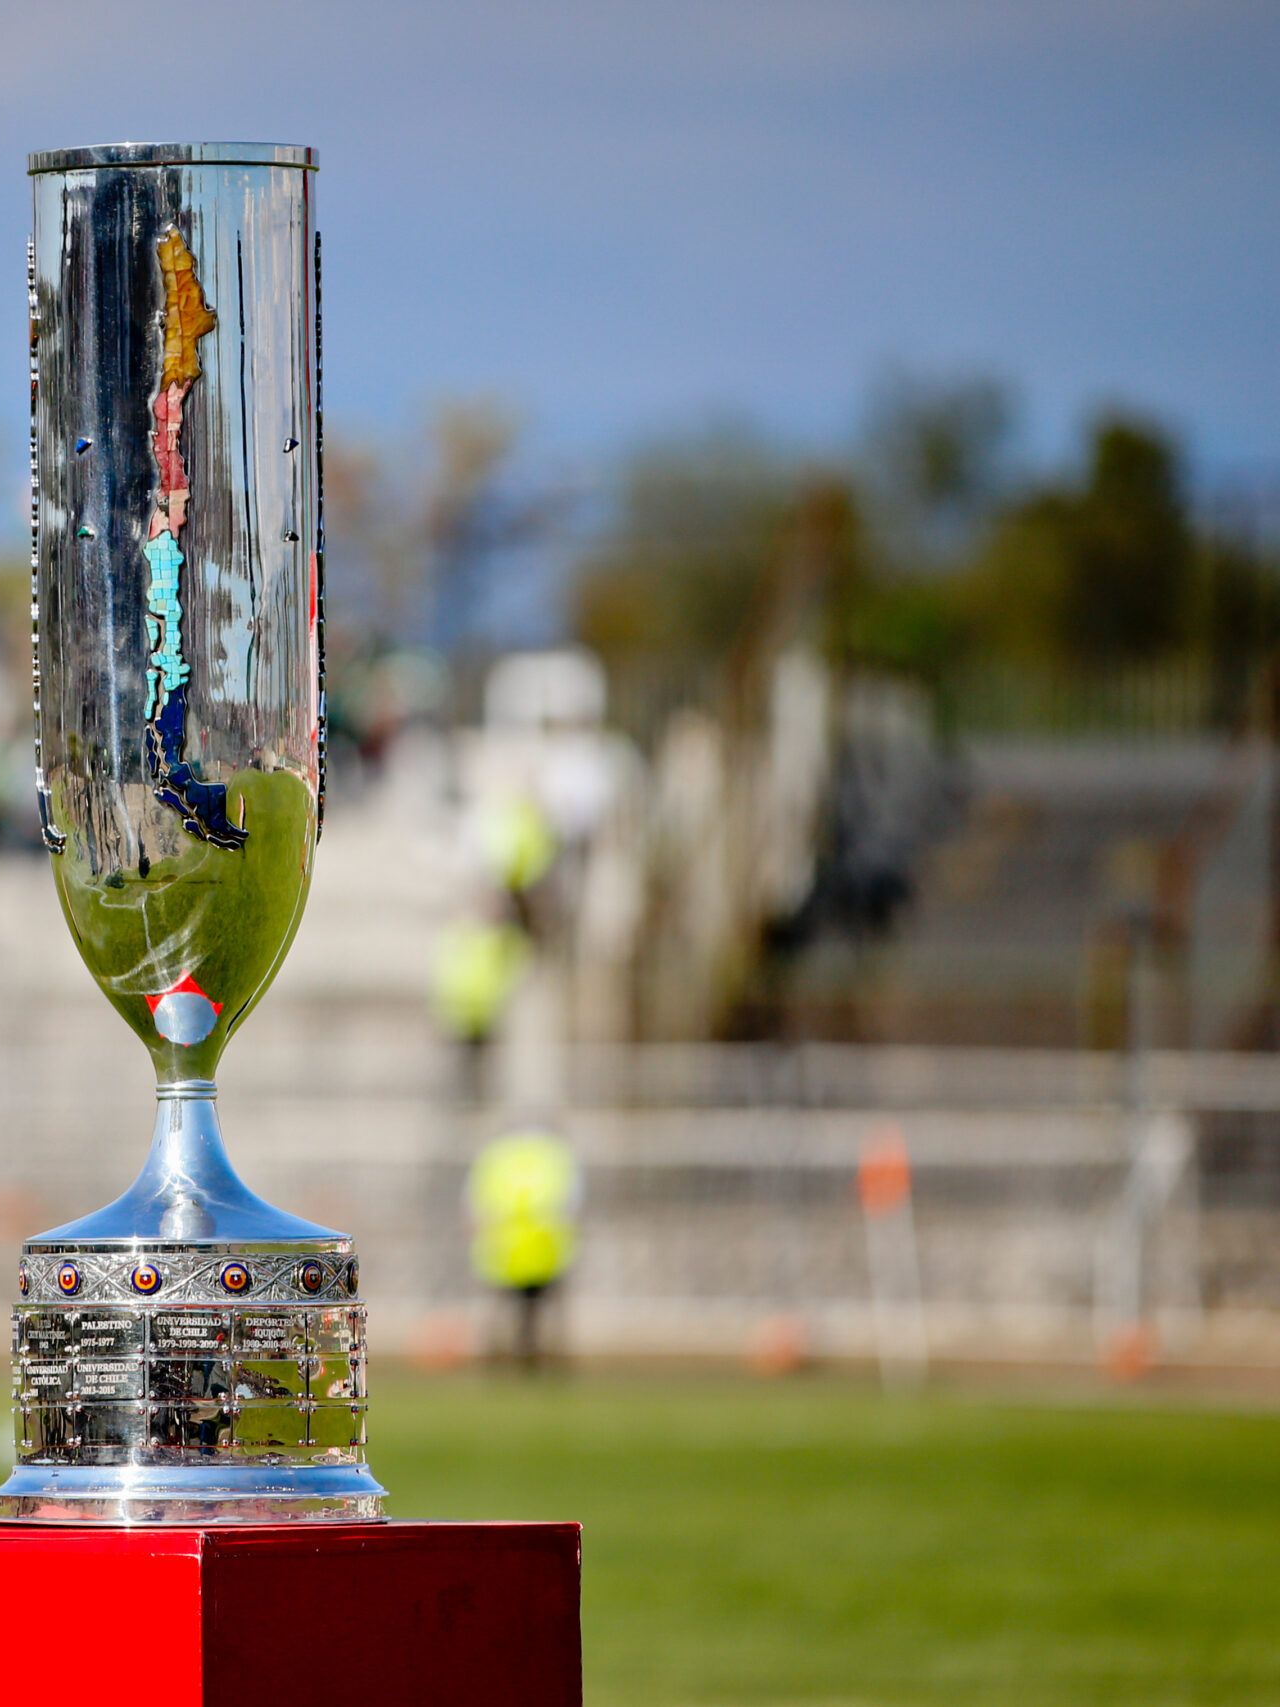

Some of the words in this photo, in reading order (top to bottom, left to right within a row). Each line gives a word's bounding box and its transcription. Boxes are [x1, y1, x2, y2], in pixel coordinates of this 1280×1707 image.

[81, 1320, 132, 1330] PALESTINO
[156, 1316, 222, 1326] UNIVERSIDAD
[169, 1327, 181, 1336] DE
[182, 1327, 208, 1337] CHILE
[80, 1338, 115, 1347] 1975-1977
[27, 1365, 69, 1374] UNIVERSIDAD
[77, 1362, 139, 1373] UNIVERSIDAD
[31, 1374, 62, 1386] CATÓLICA
[85, 1375, 98, 1384] DE
[99, 1374, 128, 1384] CHILE
[80, 1386, 116, 1395] 2013-2015
